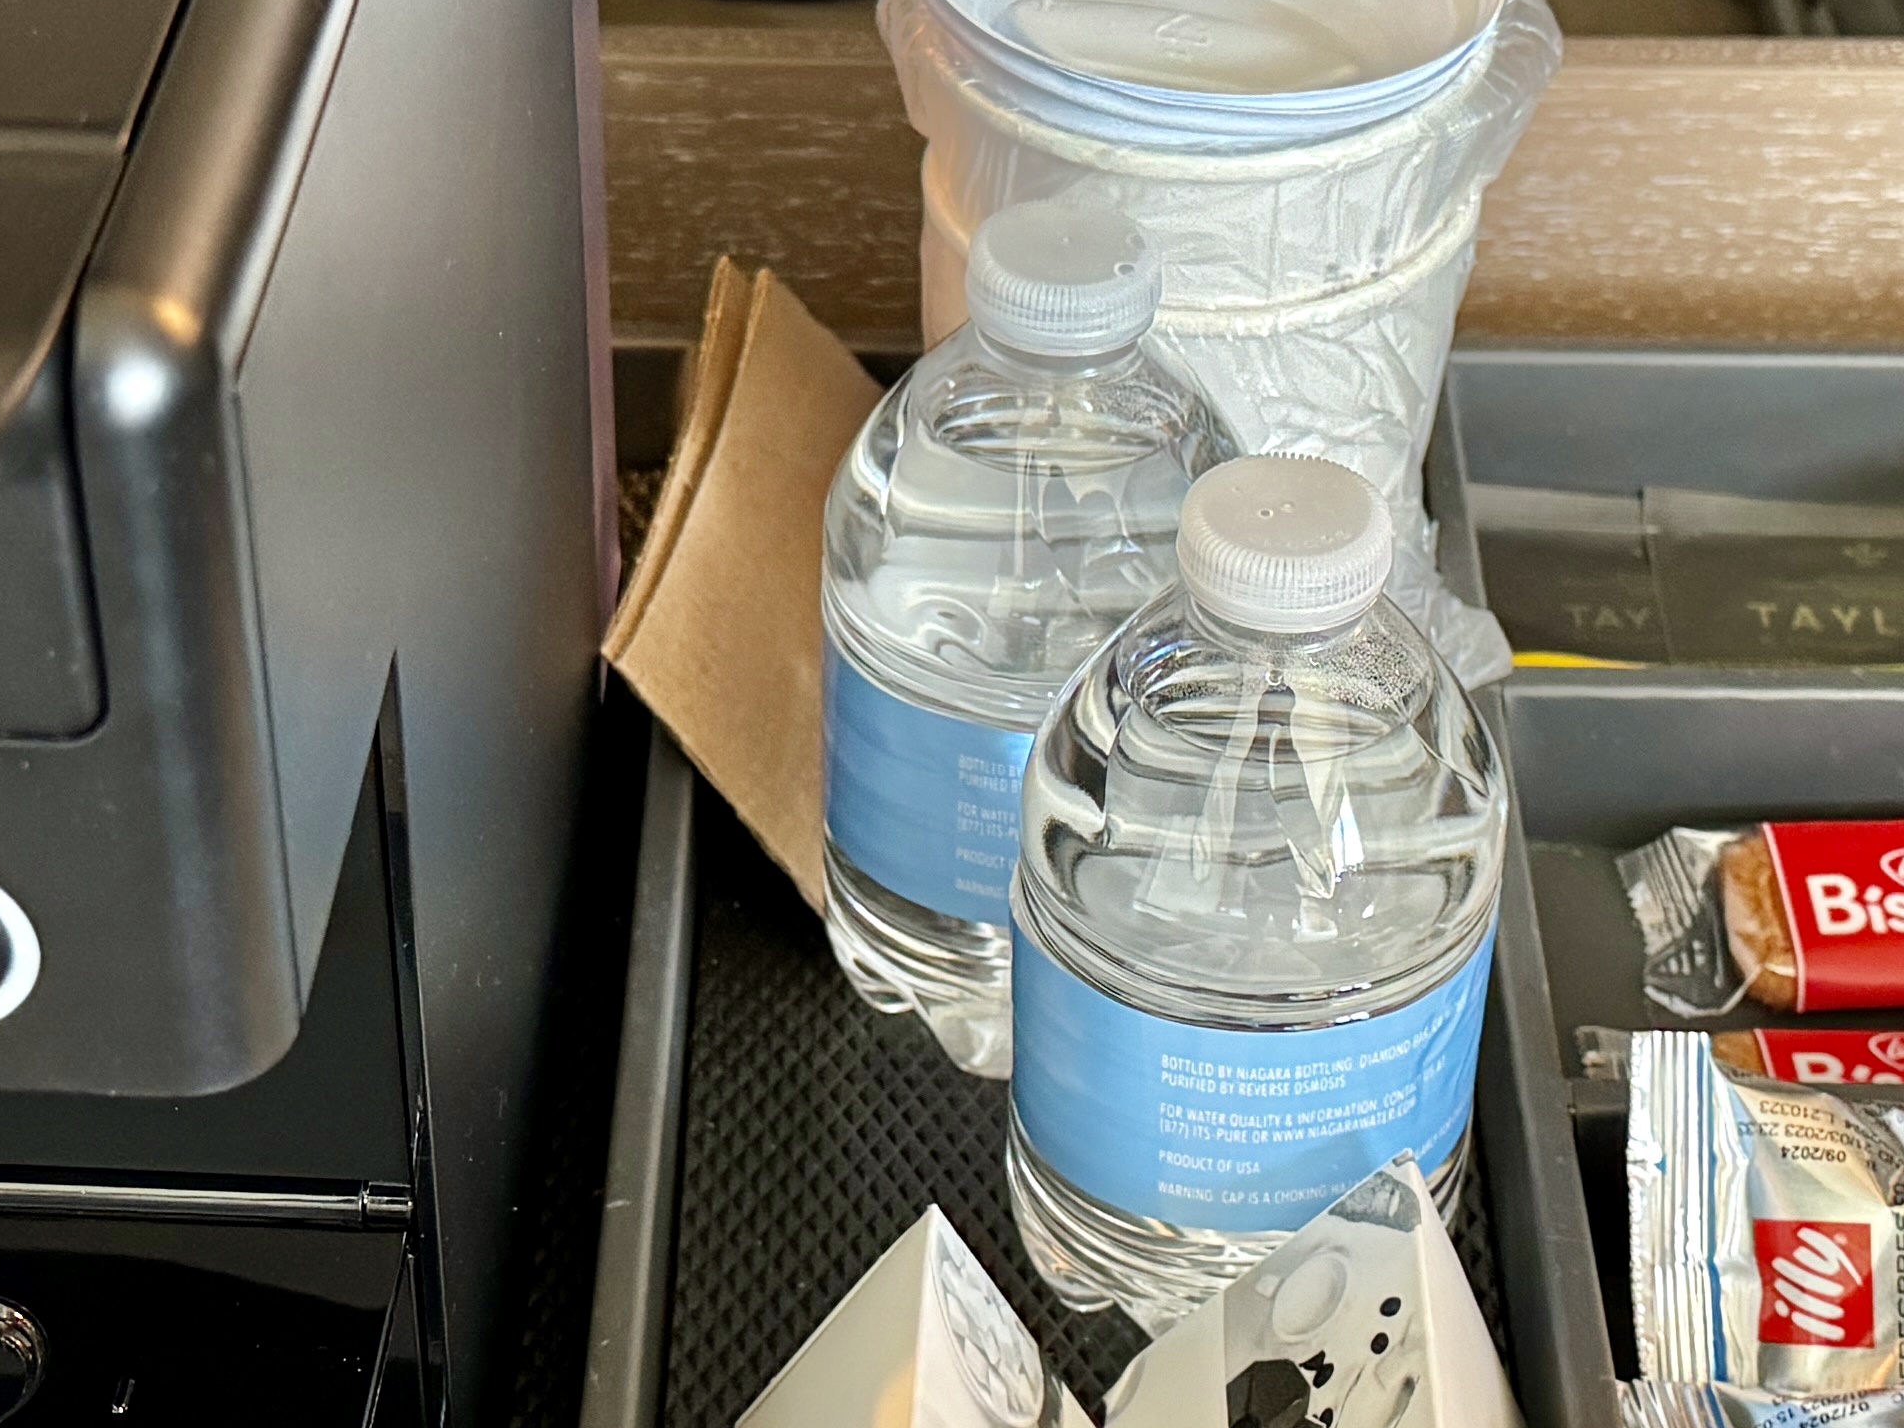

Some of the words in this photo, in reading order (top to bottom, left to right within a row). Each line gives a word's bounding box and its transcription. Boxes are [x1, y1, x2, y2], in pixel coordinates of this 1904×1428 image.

[1162, 1053, 1214, 1077] BOTTLED
[1218, 1063, 1233, 1078] BY
[1236, 1067, 1291, 1080] NIAGARA
[1162, 1073, 1216, 1094] PURIFIED
[1220, 1080, 1235, 1095] BY
[1239, 1082, 1290, 1097] REVERSE
[1294, 1074, 1346, 1096] OSMOSIS
[1160, 1103, 1183, 1120] FOR
[1186, 1110, 1227, 1126] WATER
[1230, 1113, 1281, 1128] QUALITY
[1252, 1129, 1269, 1143] OR
[1159, 1149, 1213, 1171] PRODUCT
[1217, 1158, 1233, 1173] OF
[1236, 1160, 1261, 1174] USA
[1782, 1145, 1847, 1163] 09/2024
[1222, 1189, 1244, 1204] CAP
[1248, 1190, 1259, 1204] IS
[1263, 1190, 1271, 1203] A
[1274, 1186, 1329, 1203] CHOKING
[1771, 1227, 1863, 1341] illy
